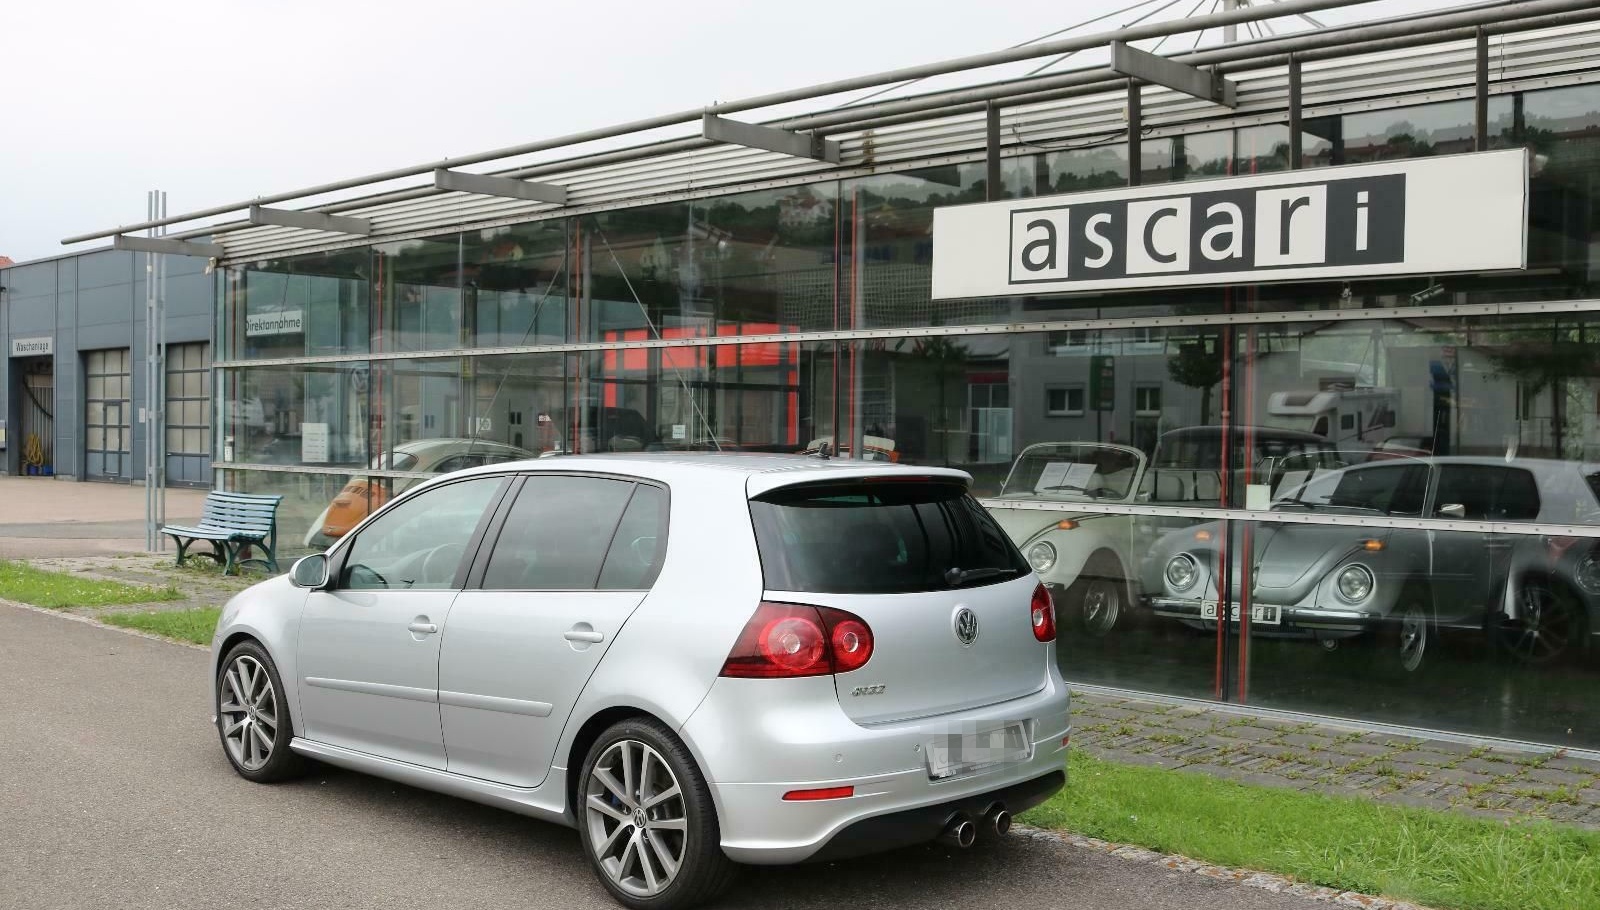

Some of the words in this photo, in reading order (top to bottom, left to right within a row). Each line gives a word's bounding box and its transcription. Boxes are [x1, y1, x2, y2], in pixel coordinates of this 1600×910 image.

[1020, 190, 1369, 273] ascari
[15, 342, 49, 353] Waschanlage
[1205, 604, 1272, 620] acri
